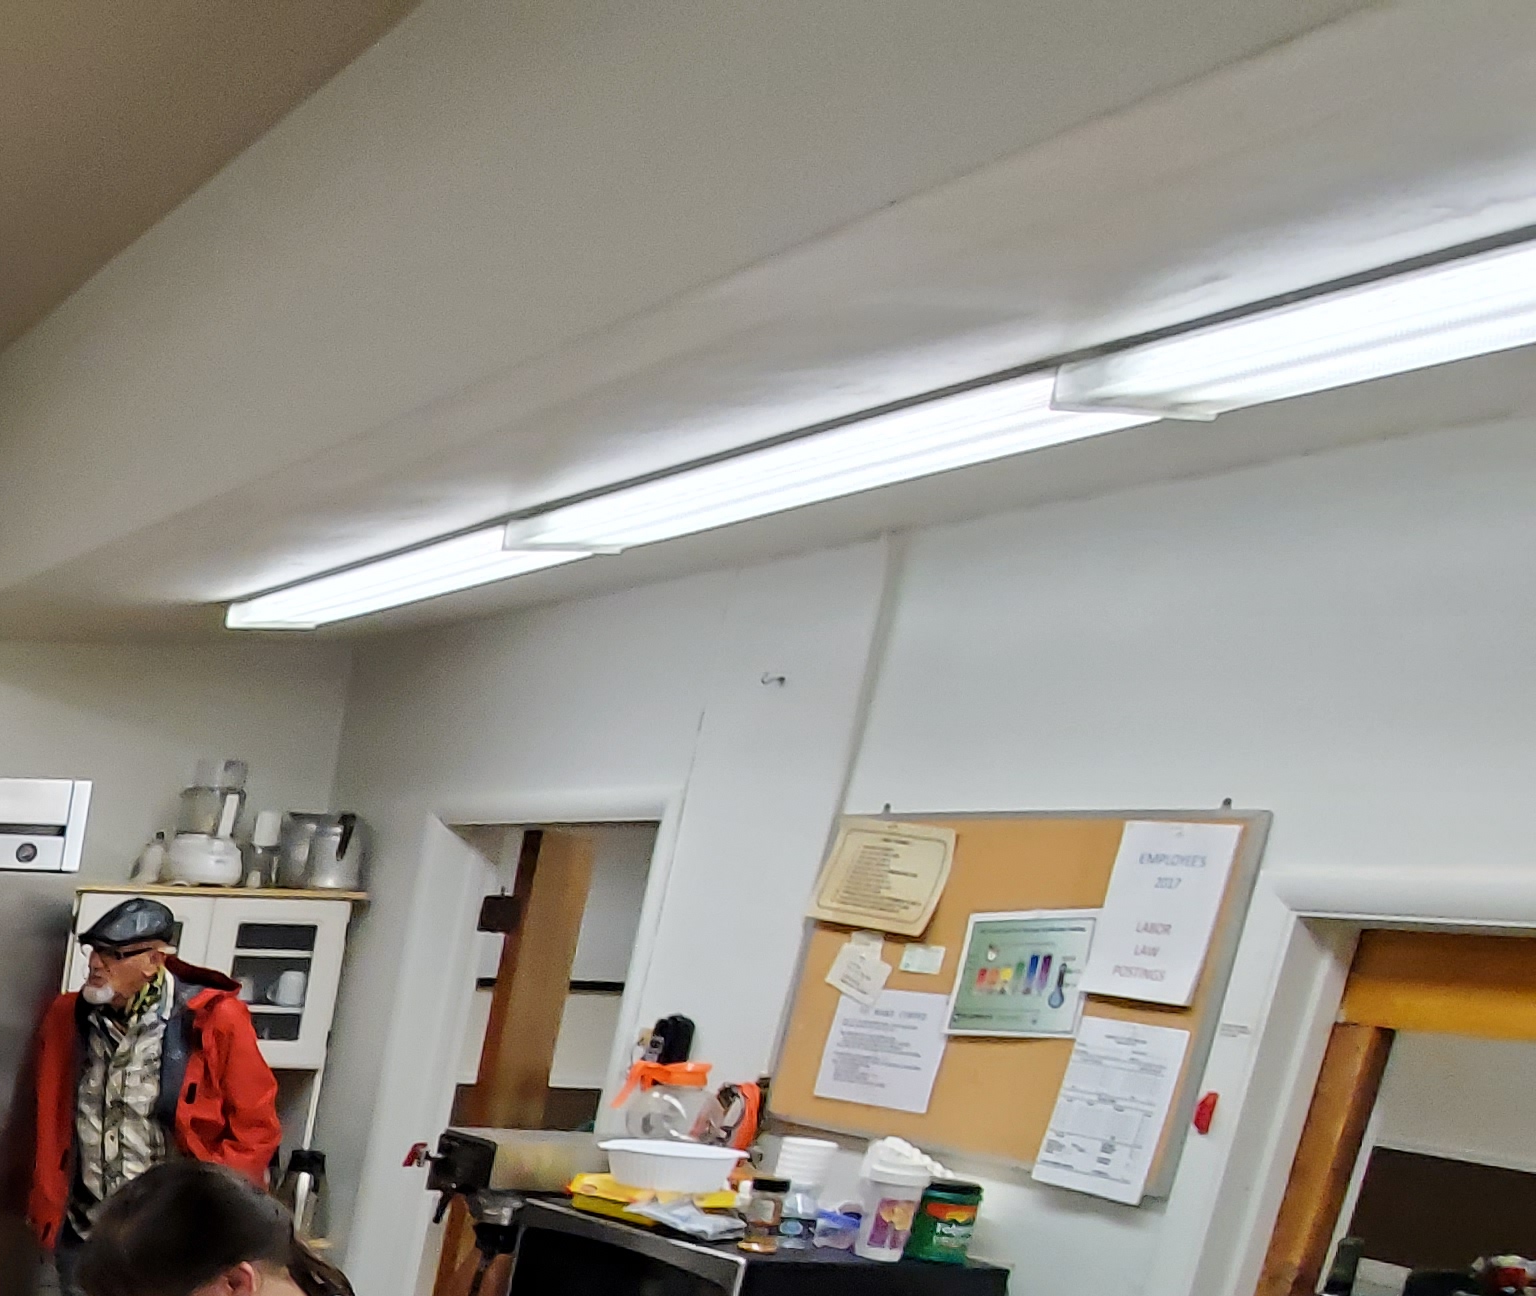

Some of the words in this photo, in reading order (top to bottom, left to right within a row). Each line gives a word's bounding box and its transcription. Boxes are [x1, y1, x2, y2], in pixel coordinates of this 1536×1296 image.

[1138, 852, 1208, 869] EMPLOYEES
[1135, 921, 1173, 936] LABOR
[1133, 943, 1161, 958] LAW
[1111, 964, 1167, 983] POSTINGS
